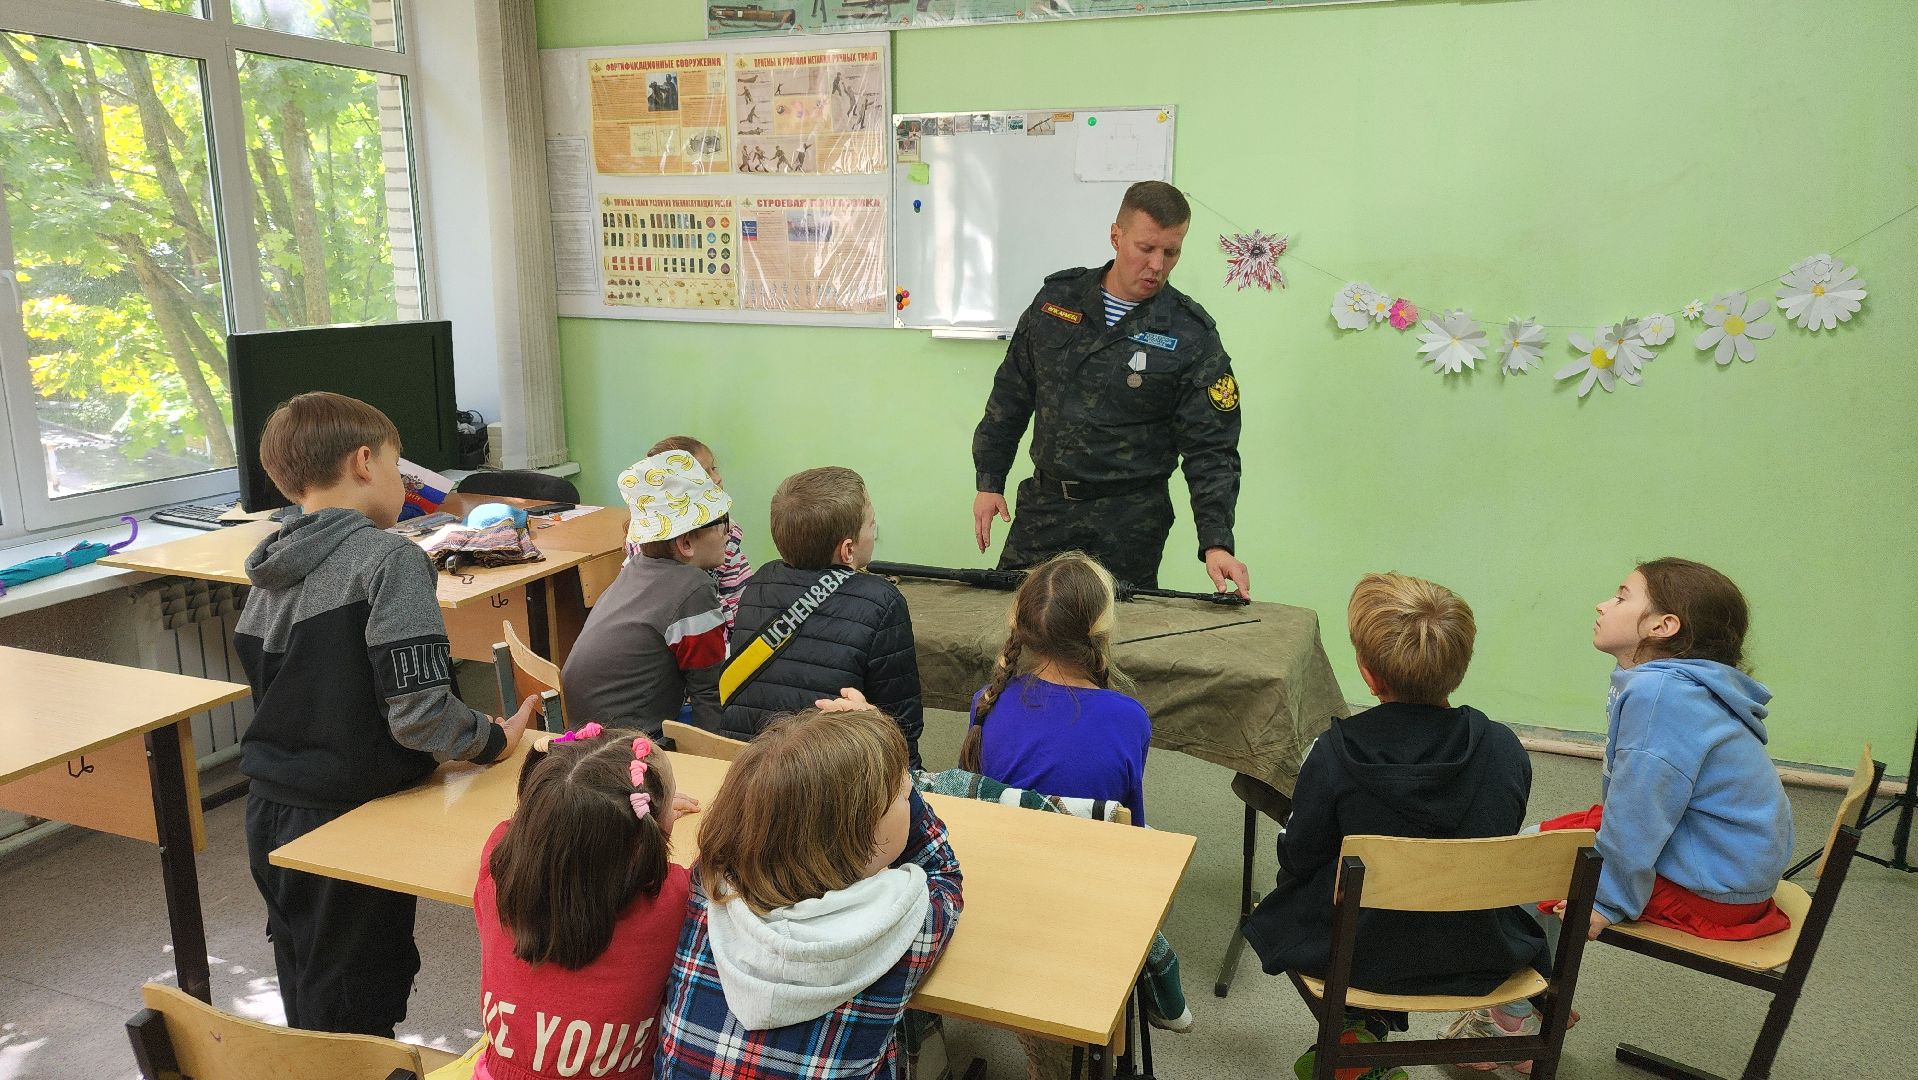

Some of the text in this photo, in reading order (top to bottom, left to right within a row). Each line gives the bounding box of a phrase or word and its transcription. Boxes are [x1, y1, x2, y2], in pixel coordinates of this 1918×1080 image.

[606, 58, 721, 71] ФОРТИФИКАЦИОННЫЕ СООРУЖЕНИЯ
[757, 199, 807, 207] СТРОЕВАЯ
